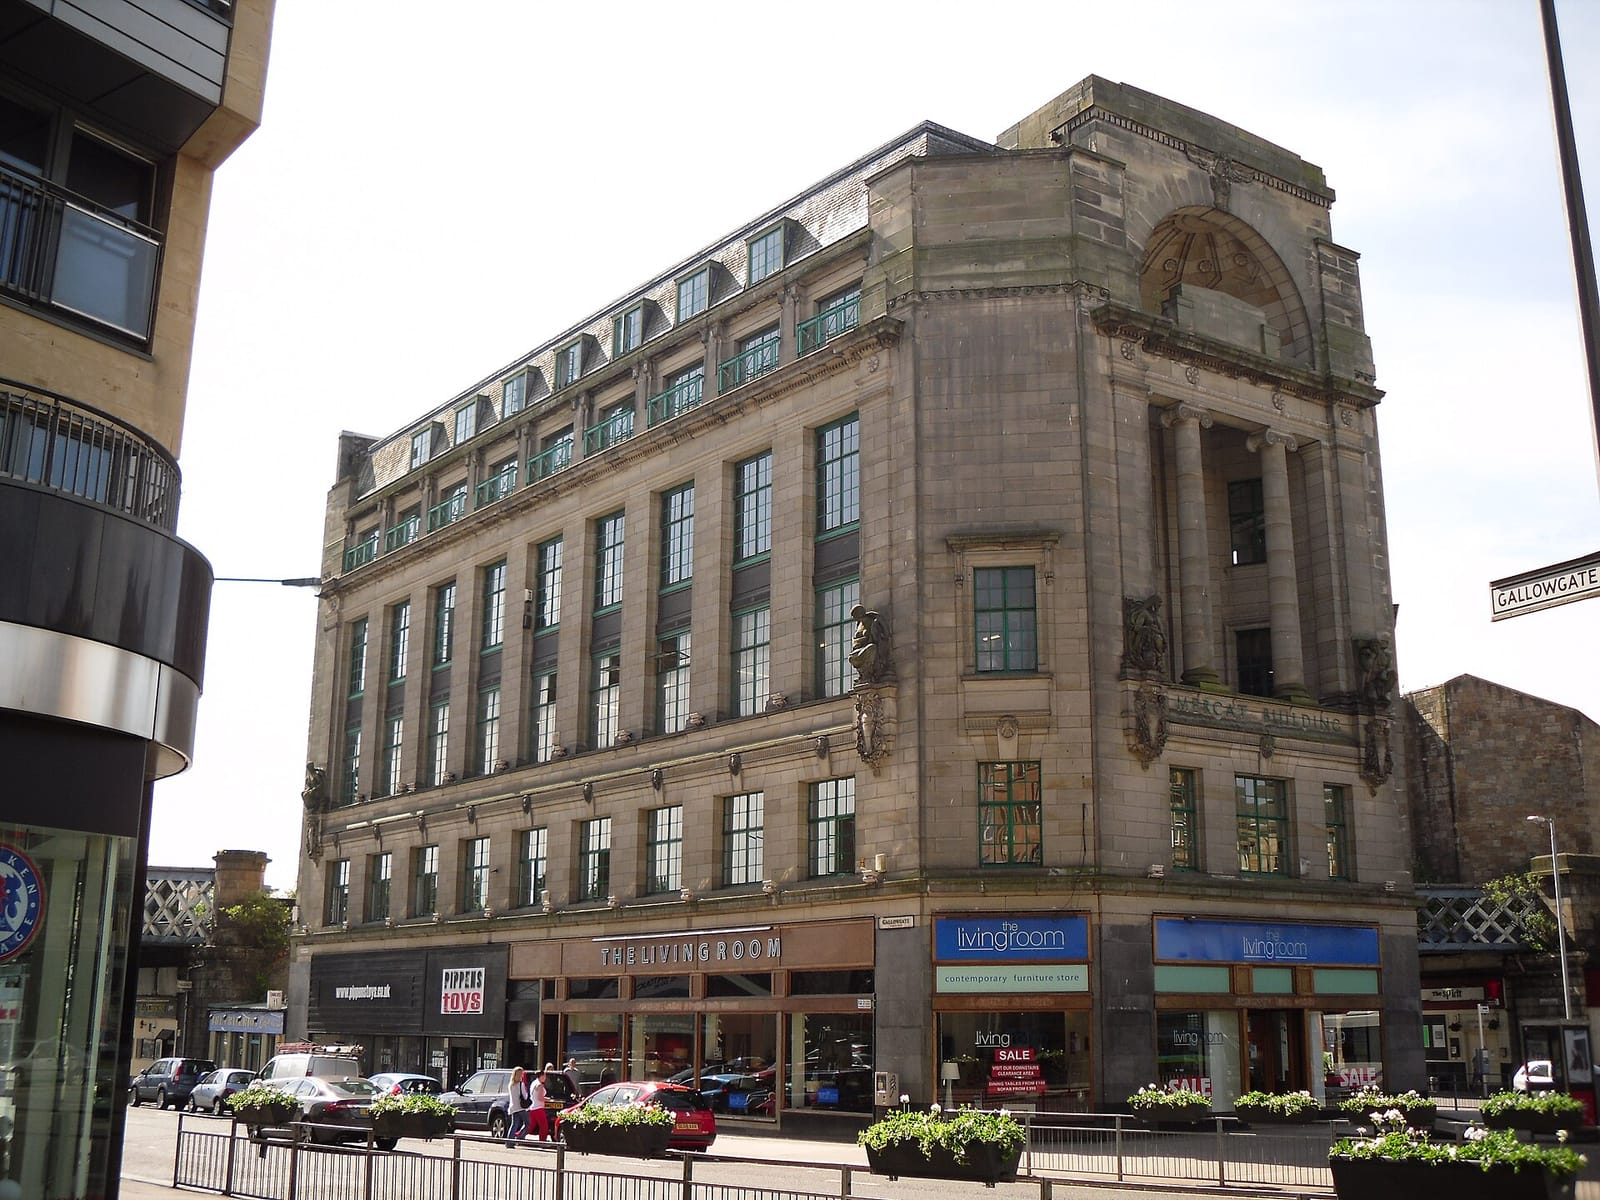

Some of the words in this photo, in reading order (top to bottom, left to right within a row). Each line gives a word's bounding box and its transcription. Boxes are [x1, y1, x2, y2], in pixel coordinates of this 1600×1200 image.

[1498, 569, 1598, 607] GALLOWGATE
[1177, 697, 1247, 719] MERCAT
[1002, 921, 1019, 931] the
[601, 946, 635, 966] THE
[641, 942, 709, 965] LIVING
[716, 938, 781, 960] ROOM
[444, 970, 482, 989] PIPPENS
[945, 974, 1008, 984] contemporary
[1013, 973, 1054, 982] furniture
[1056, 973, 1080, 981] store
[443, 992, 481, 1013] toys
[999, 1050, 1031, 1061] SALE
[1168, 1077, 1212, 1097] SALE
[1339, 1067, 1377, 1087] SALE
